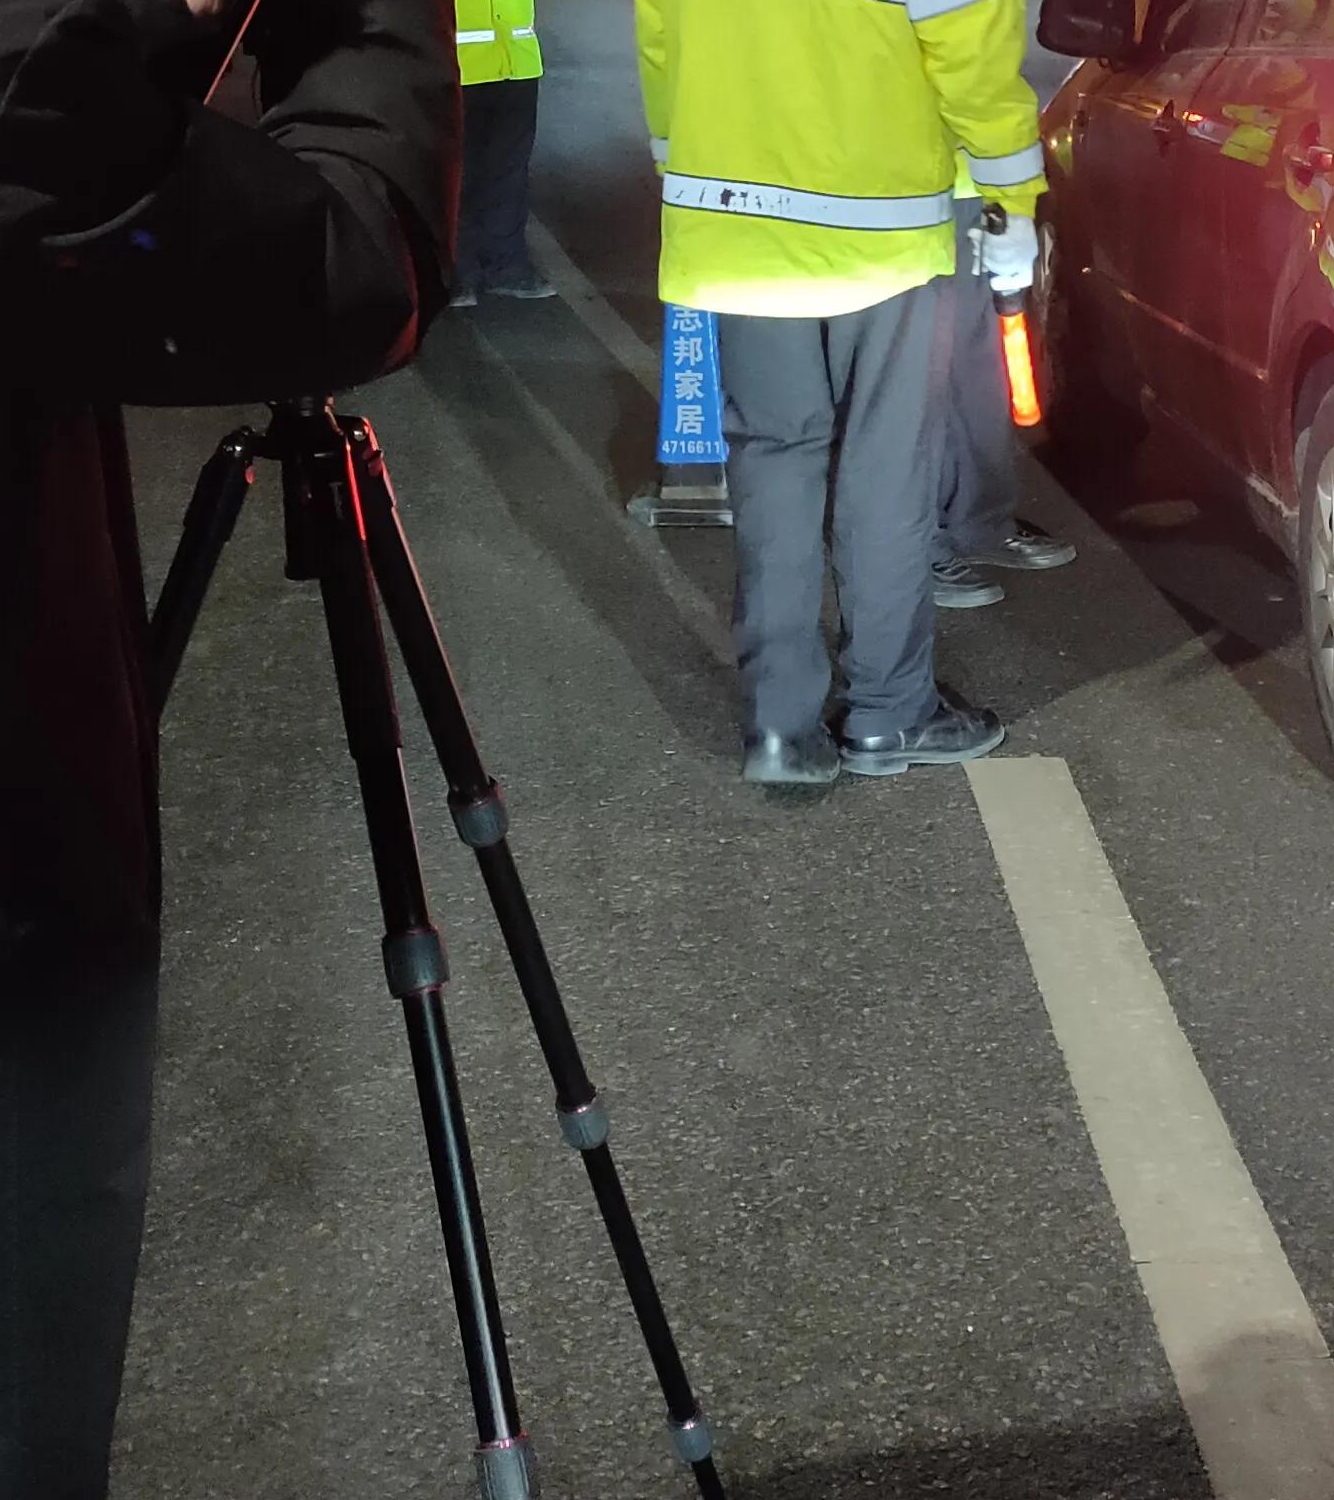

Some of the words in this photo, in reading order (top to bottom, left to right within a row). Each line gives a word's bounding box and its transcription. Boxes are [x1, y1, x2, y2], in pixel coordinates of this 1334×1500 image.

[672, 305, 706, 435] 志邦家居
[661, 439, 720, 455] 4716611
